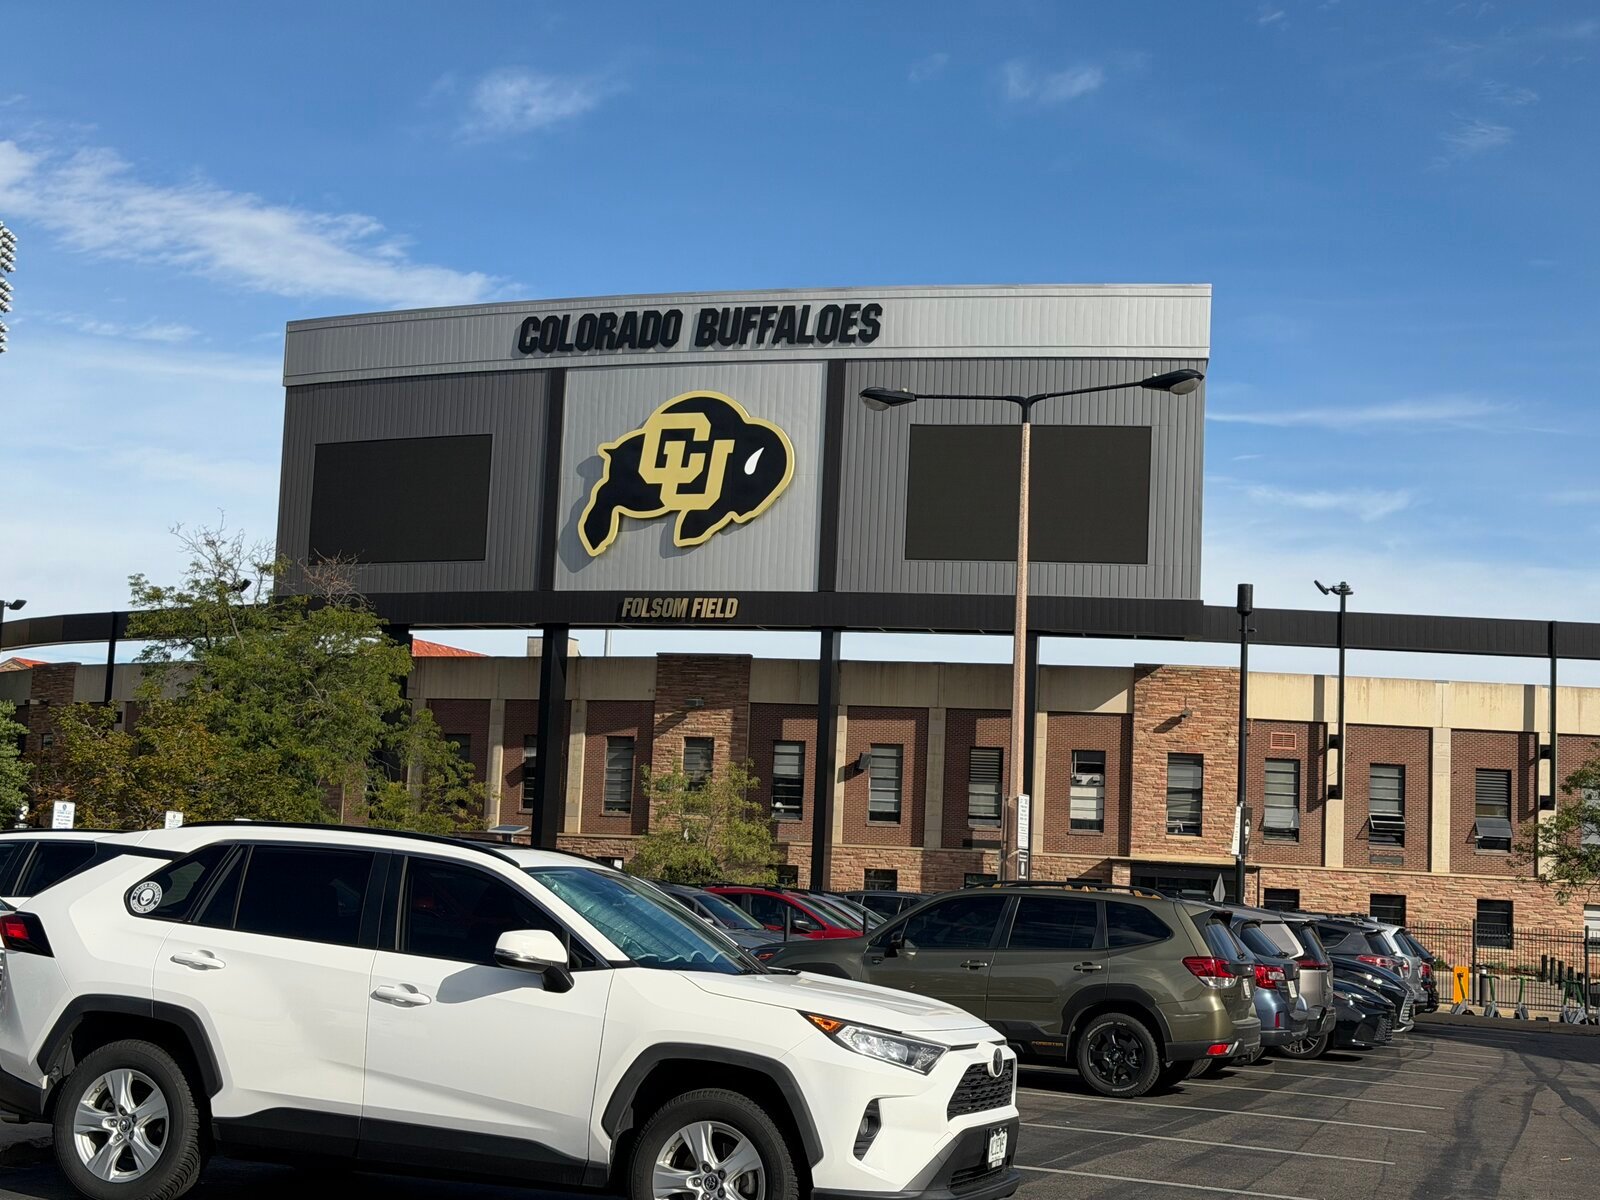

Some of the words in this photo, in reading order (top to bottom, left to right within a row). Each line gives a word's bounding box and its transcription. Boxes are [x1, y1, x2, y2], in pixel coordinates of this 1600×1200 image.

[518, 309, 684, 354] COLORADO
[694, 303, 884, 348] BUFFALOES
[638, 412, 736, 510] CU
[621, 597, 690, 618] FOLSOM
[690, 597, 739, 619] FIELD
